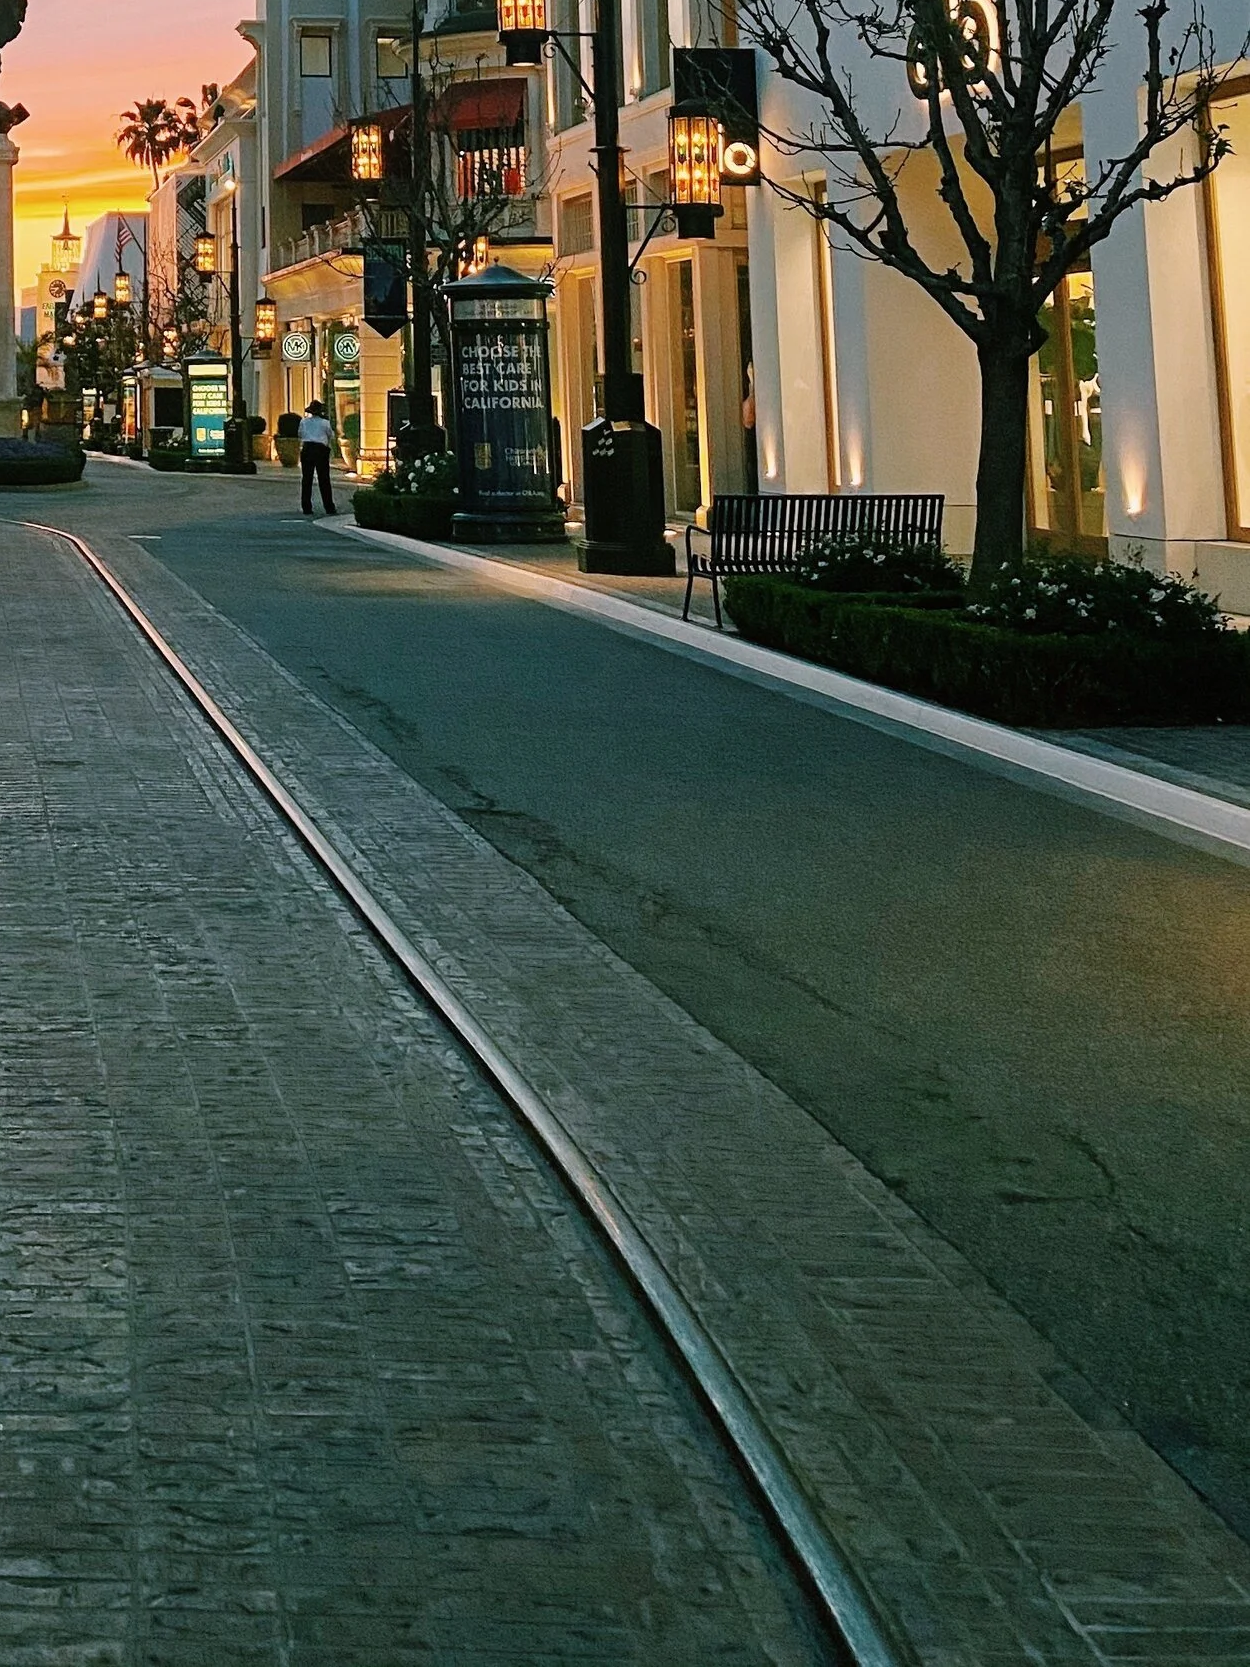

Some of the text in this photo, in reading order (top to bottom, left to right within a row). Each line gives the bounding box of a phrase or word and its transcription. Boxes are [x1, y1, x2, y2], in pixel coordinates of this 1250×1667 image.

[461, 345, 519, 358] CHOOSE
[462, 362, 532, 375] BEST CARE
[463, 379, 542, 392] FOR KIDS IN
[464, 397, 544, 409] CALIFORNIA
